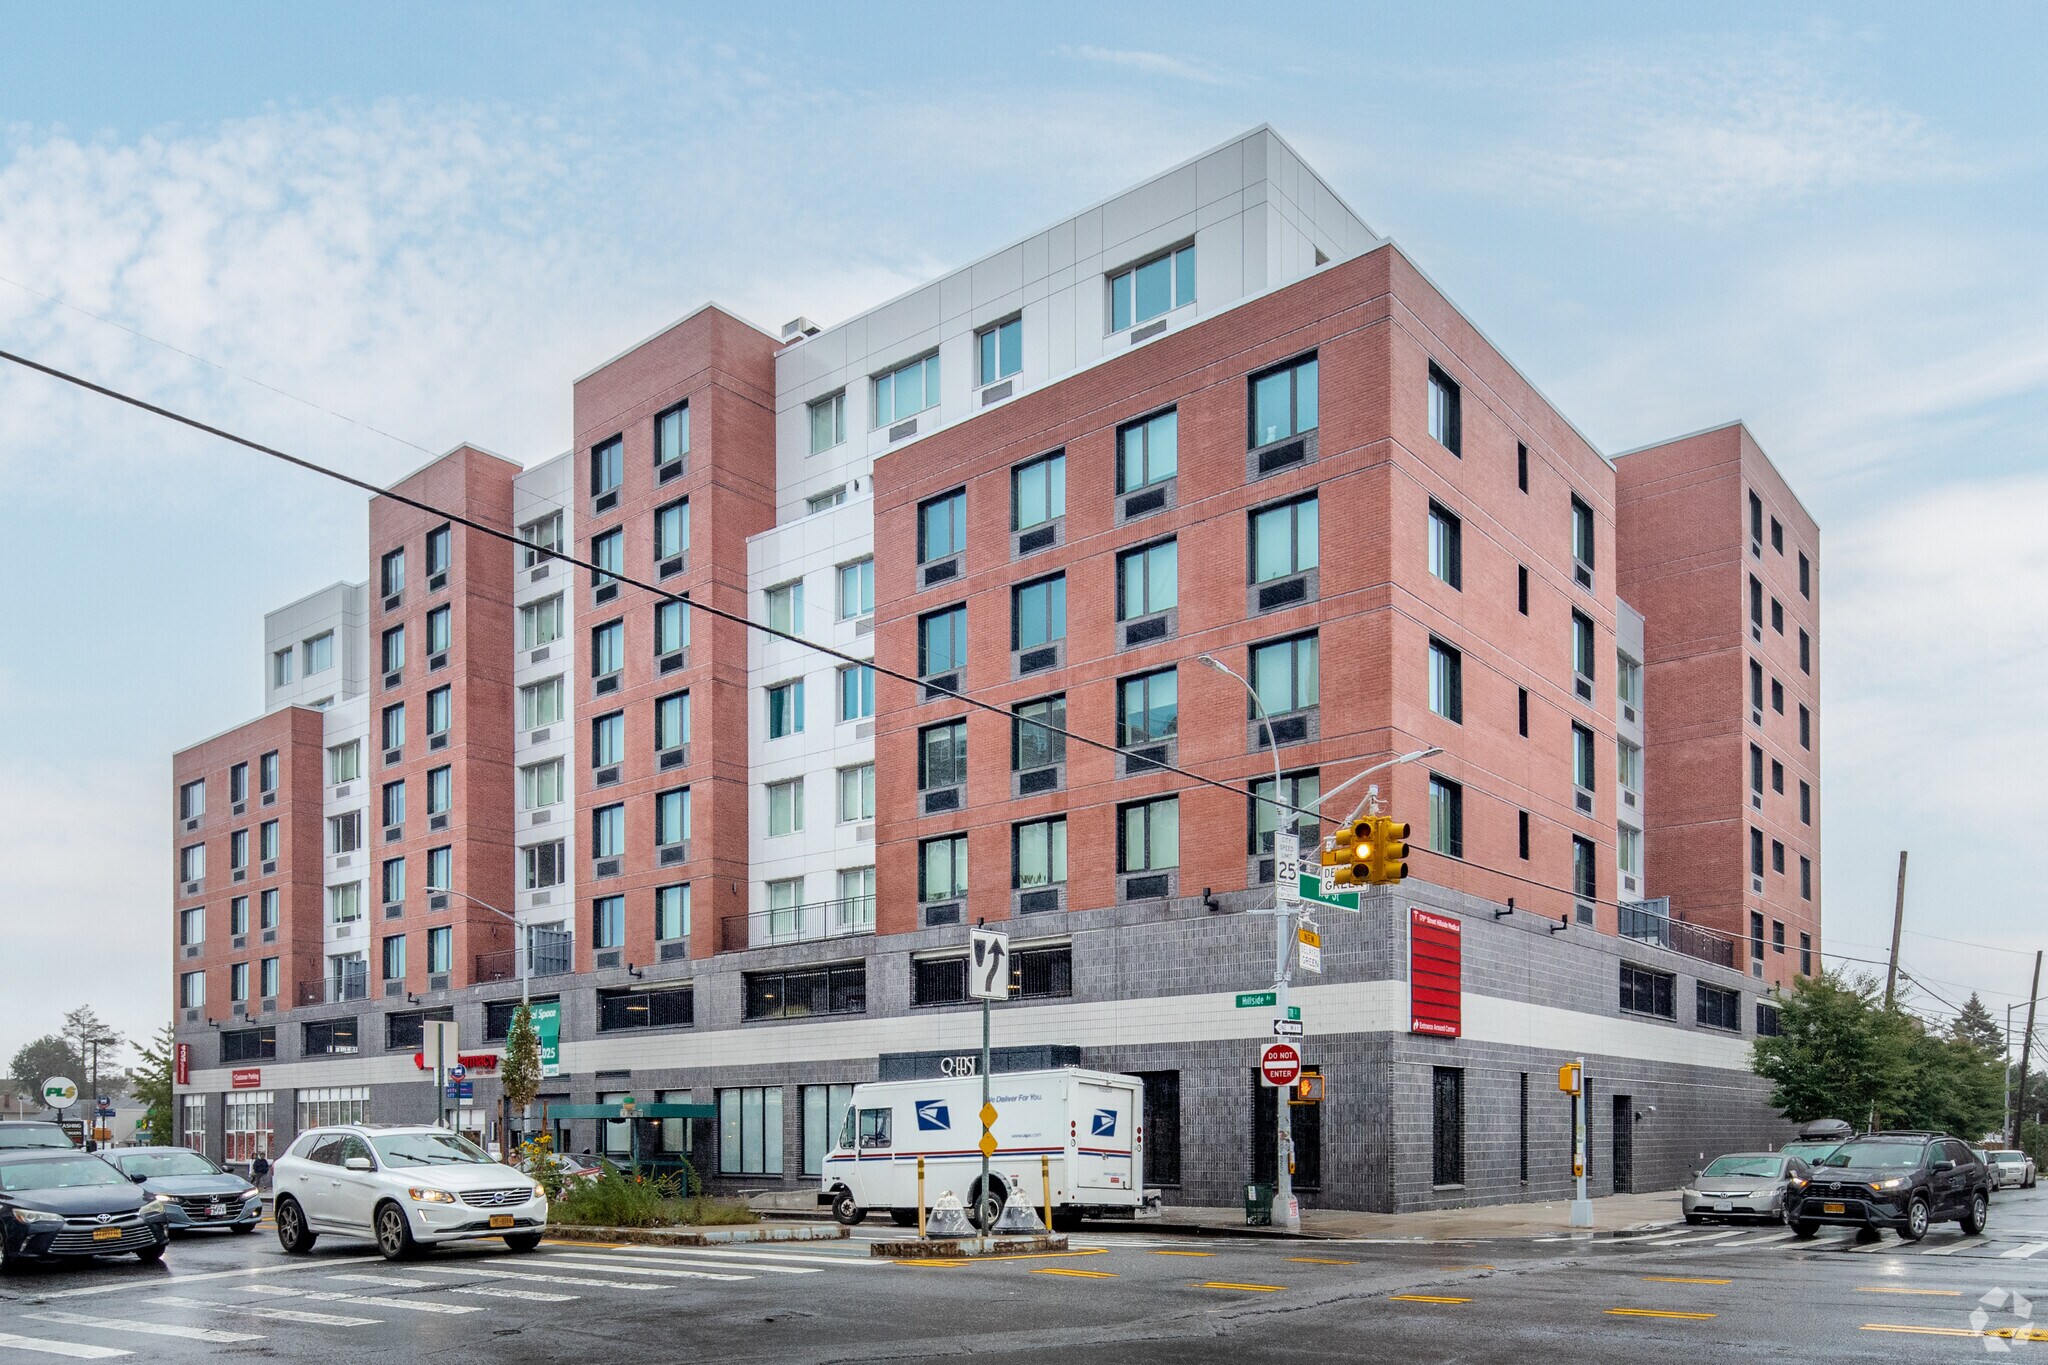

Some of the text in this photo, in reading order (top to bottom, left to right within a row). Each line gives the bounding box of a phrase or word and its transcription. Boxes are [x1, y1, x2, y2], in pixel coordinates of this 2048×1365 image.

[1280, 843, 1294, 852] SPEED
[1279, 861, 1297, 880] 25
[1426, 916, 1437, 925] Street
[1303, 933, 1315, 943] NEW
[1242, 996, 1264, 1005] Hillside
[538, 1009, 556, 1020] Space
[540, 1047, 556, 1059] 025
[1268, 1052, 1278, 1060] DO
[458, 1053, 499, 1069] armacy
[1270, 1070, 1292, 1078] ENTER
[995, 1095, 1017, 1103] Deliver
[1018, 1094, 1029, 1102] For
[1030, 1093, 1042, 1101] You.
